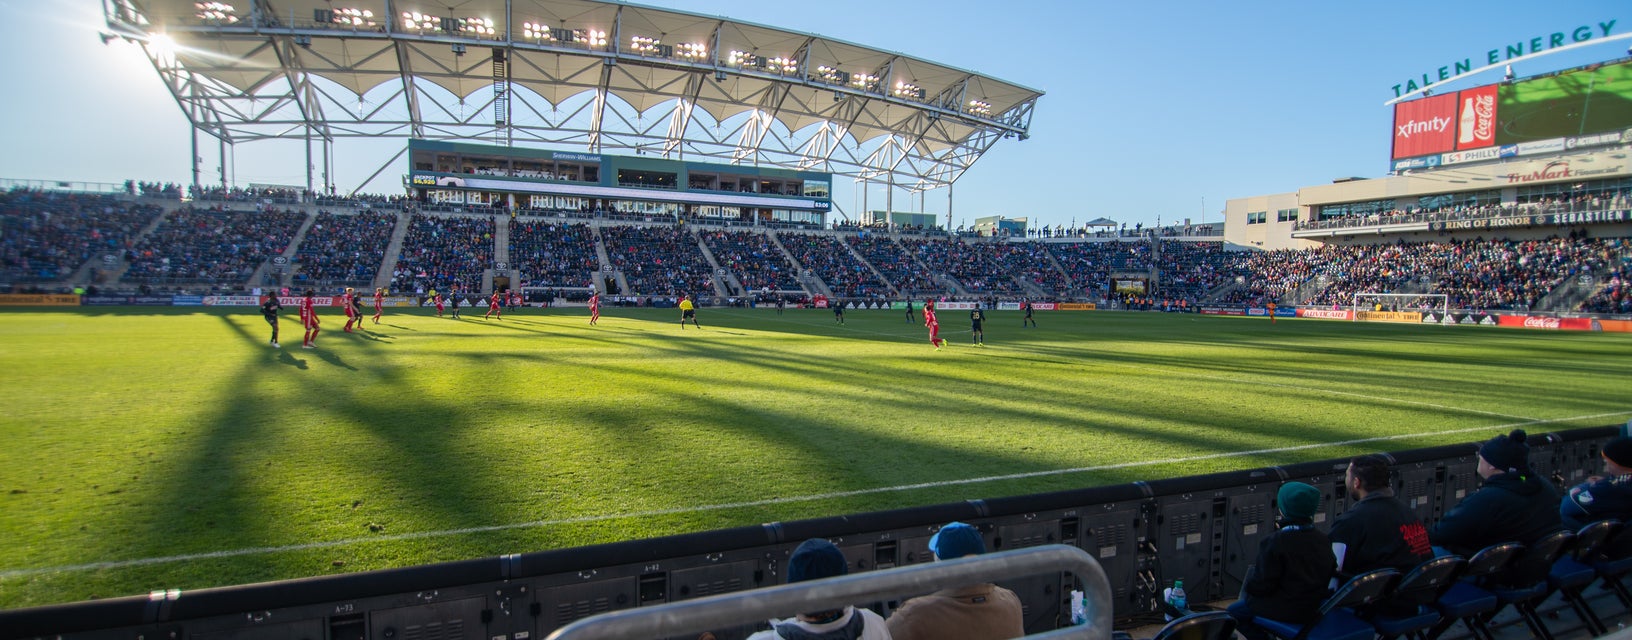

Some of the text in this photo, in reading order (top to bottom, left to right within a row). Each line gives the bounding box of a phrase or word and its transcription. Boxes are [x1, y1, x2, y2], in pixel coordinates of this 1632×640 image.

[1392, 19, 1617, 98] TALEN ENERGY
[1397, 115, 1451, 138] xfinity
[1465, 149, 1499, 161] PHILLY
[1507, 165, 1574, 183] TruMark
[1445, 217, 1531, 230] RING OF HONOR
[1553, 210, 1624, 224] SEBASTIEN
[1356, 311, 1395, 321] Continental
[335, 604, 354, 613] A-73
